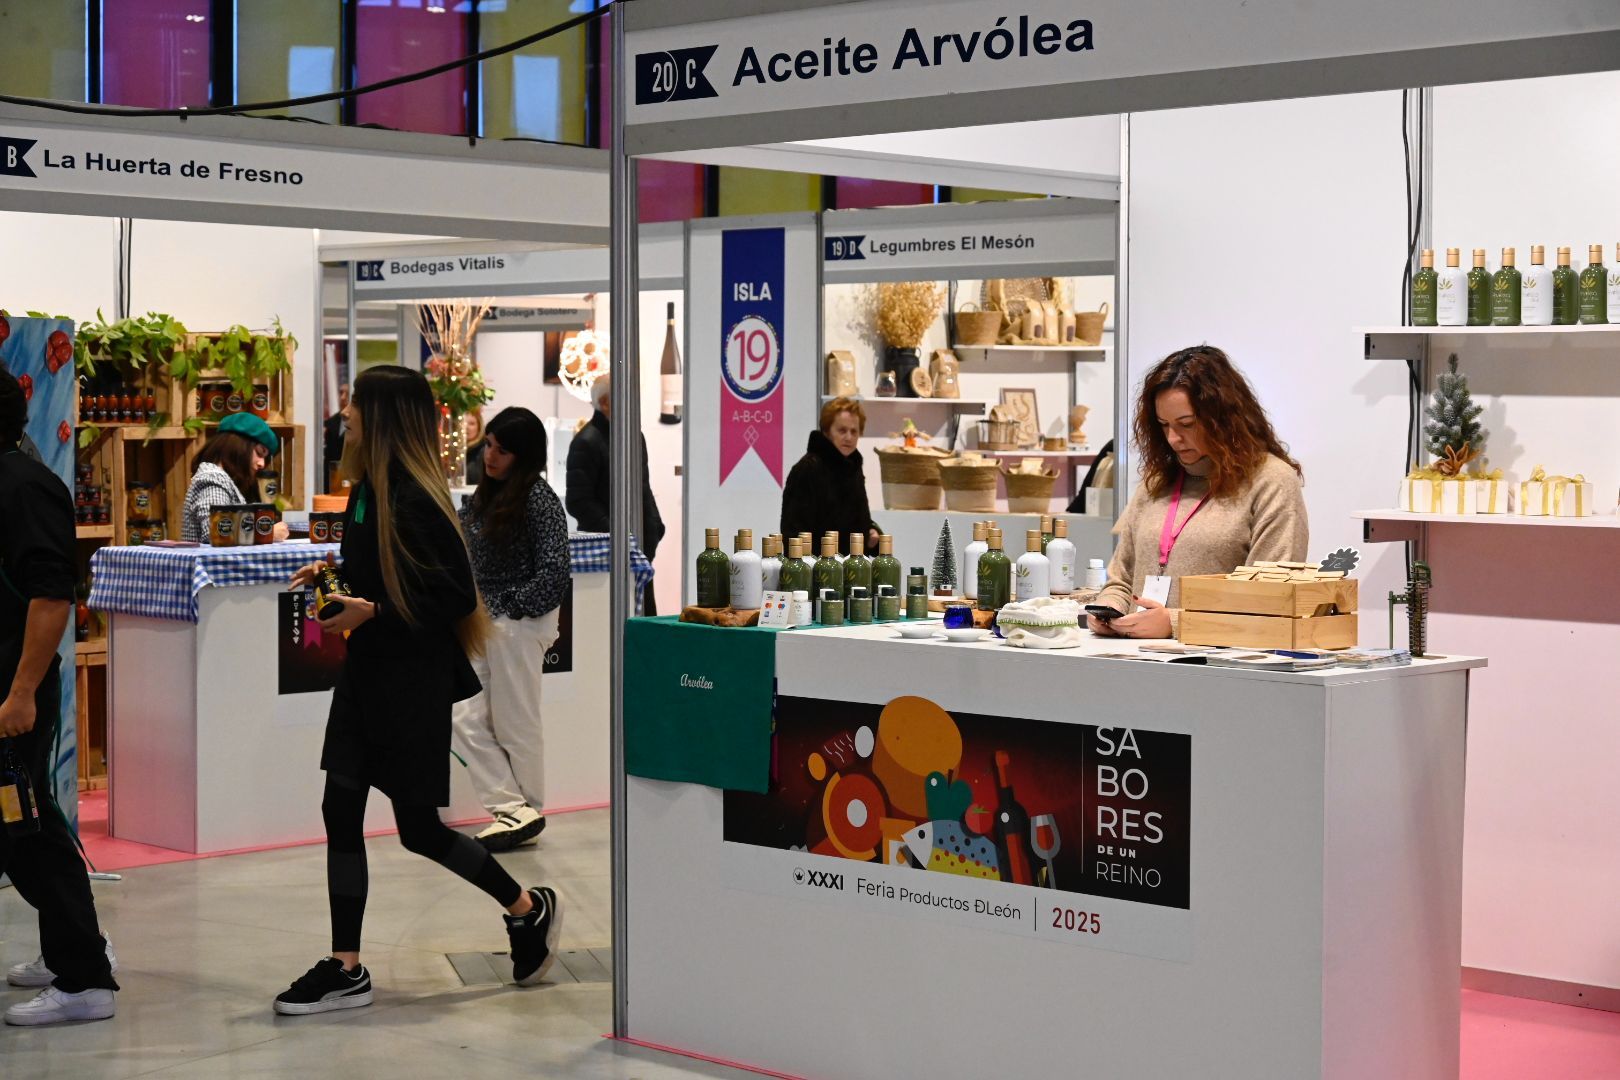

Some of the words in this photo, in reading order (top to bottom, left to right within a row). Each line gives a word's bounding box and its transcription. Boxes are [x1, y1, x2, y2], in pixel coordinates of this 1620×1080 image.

[652, 61, 673, 93] 20
[685, 58, 697, 90] C
[732, 37, 878, 87] Aceite
[892, 15, 1094, 70] Arvólea
[7, 145, 18, 168] B
[44, 149, 76, 169] La
[85, 152, 171, 176] Huerta
[180, 160, 210, 178] de
[219, 162, 303, 185] Fresno
[832, 241, 843, 256] 19
[849, 240, 856, 255] D
[870, 238, 956, 256] Legumbres
[961, 236, 976, 250] El
[981, 234, 1035, 249] Mesón
[390, 261, 454, 276] Bodegas
[459, 256, 505, 271] Vitalis
[733, 282, 773, 302] ISLA
[733, 329, 771, 381] 19
[1095, 725, 1142, 759] SA
[1097, 764, 1149, 800] BO
[1097, 805, 1164, 844] RES
[1097, 844, 1114, 856] DE
[1119, 847, 1136, 859] UN
[1096, 861, 1162, 888] REINO
[807, 869, 844, 891] XXXI
[857, 877, 895, 899] Feria
[900, 887, 970, 912] Productos
[1052, 907, 1101, 935] 2025
